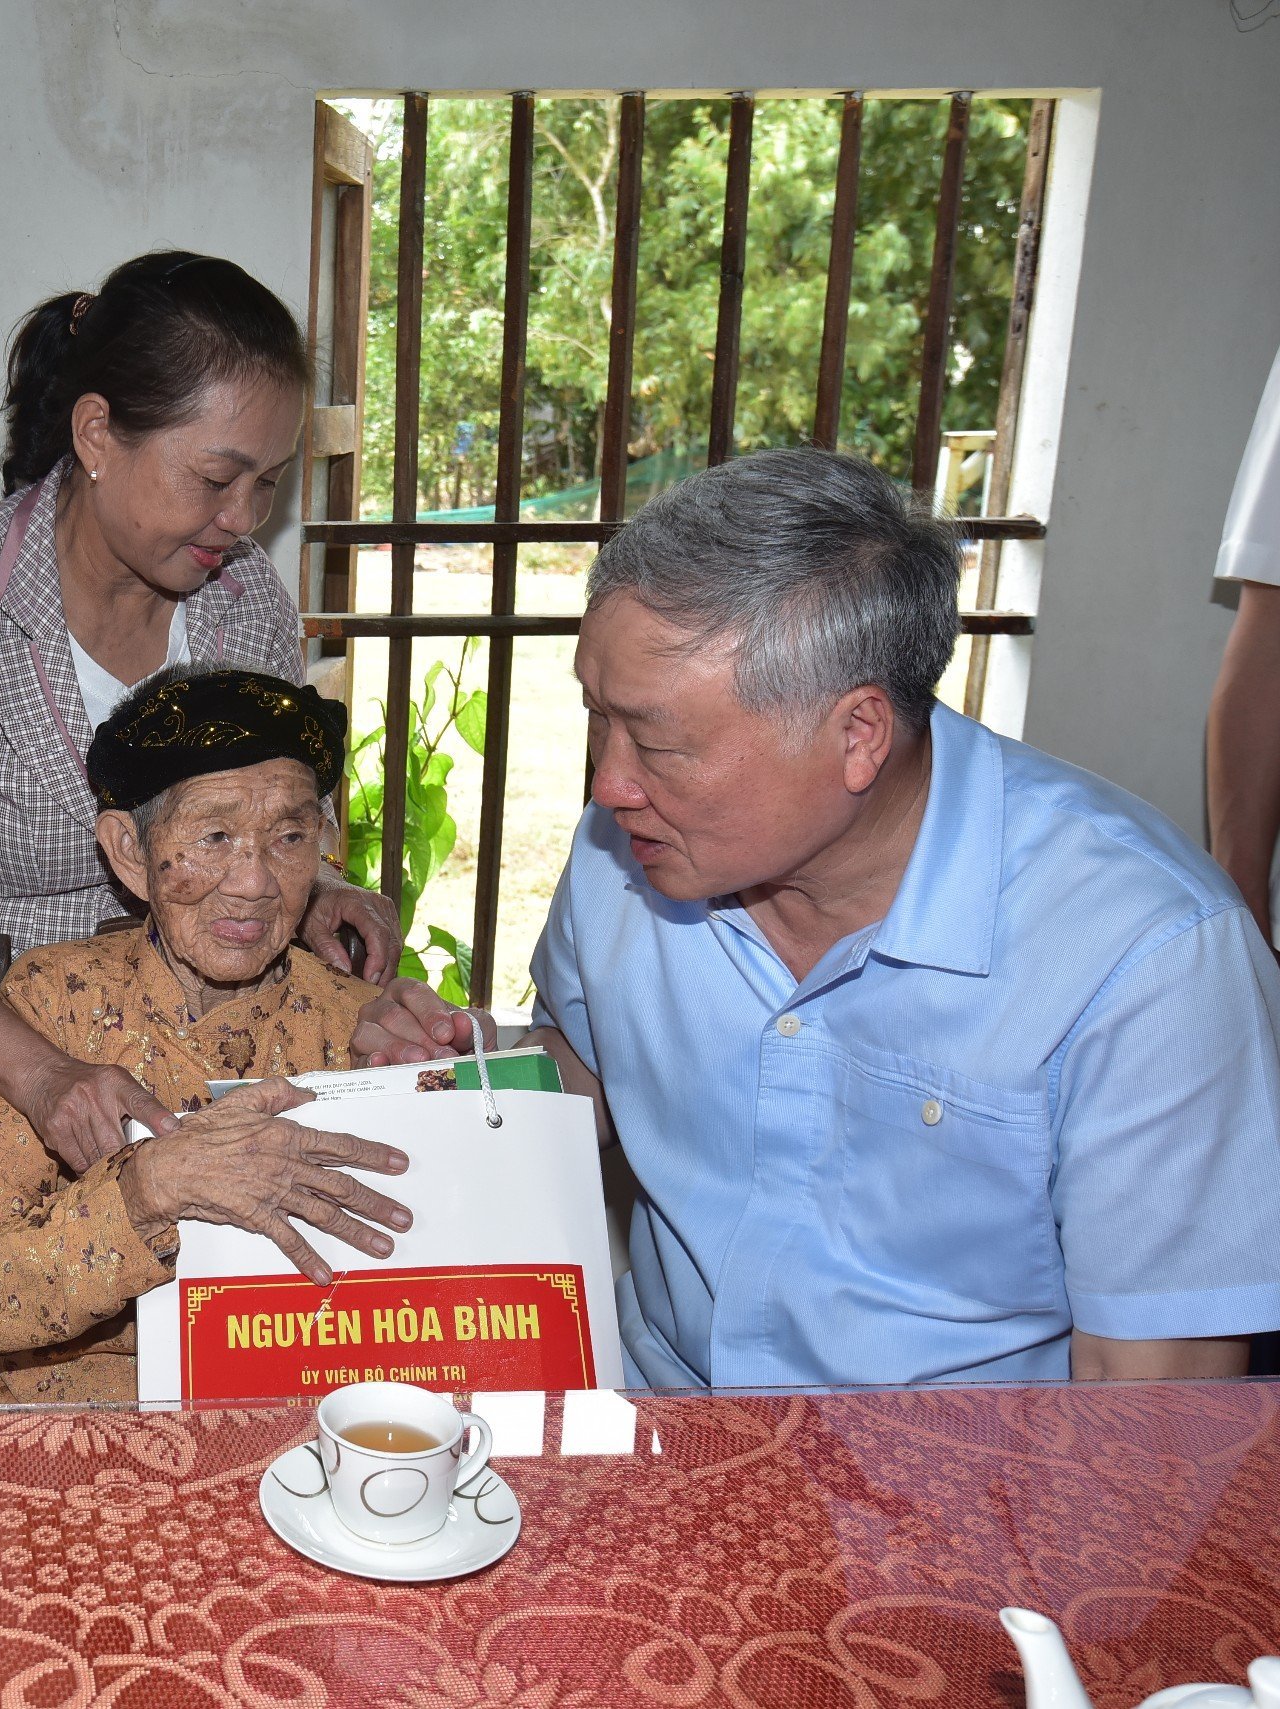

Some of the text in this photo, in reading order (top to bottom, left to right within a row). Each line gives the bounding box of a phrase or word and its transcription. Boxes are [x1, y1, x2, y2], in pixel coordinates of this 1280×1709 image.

[227, 1298, 540, 1349] NGUYỄN HÒA BÌNH
[301, 1366, 319, 1385] ỦY
[325, 1366, 360, 1384] VIÊN
[389, 1363, 437, 1382] CHÍNH
[442, 1365, 466, 1384] TRỊ
